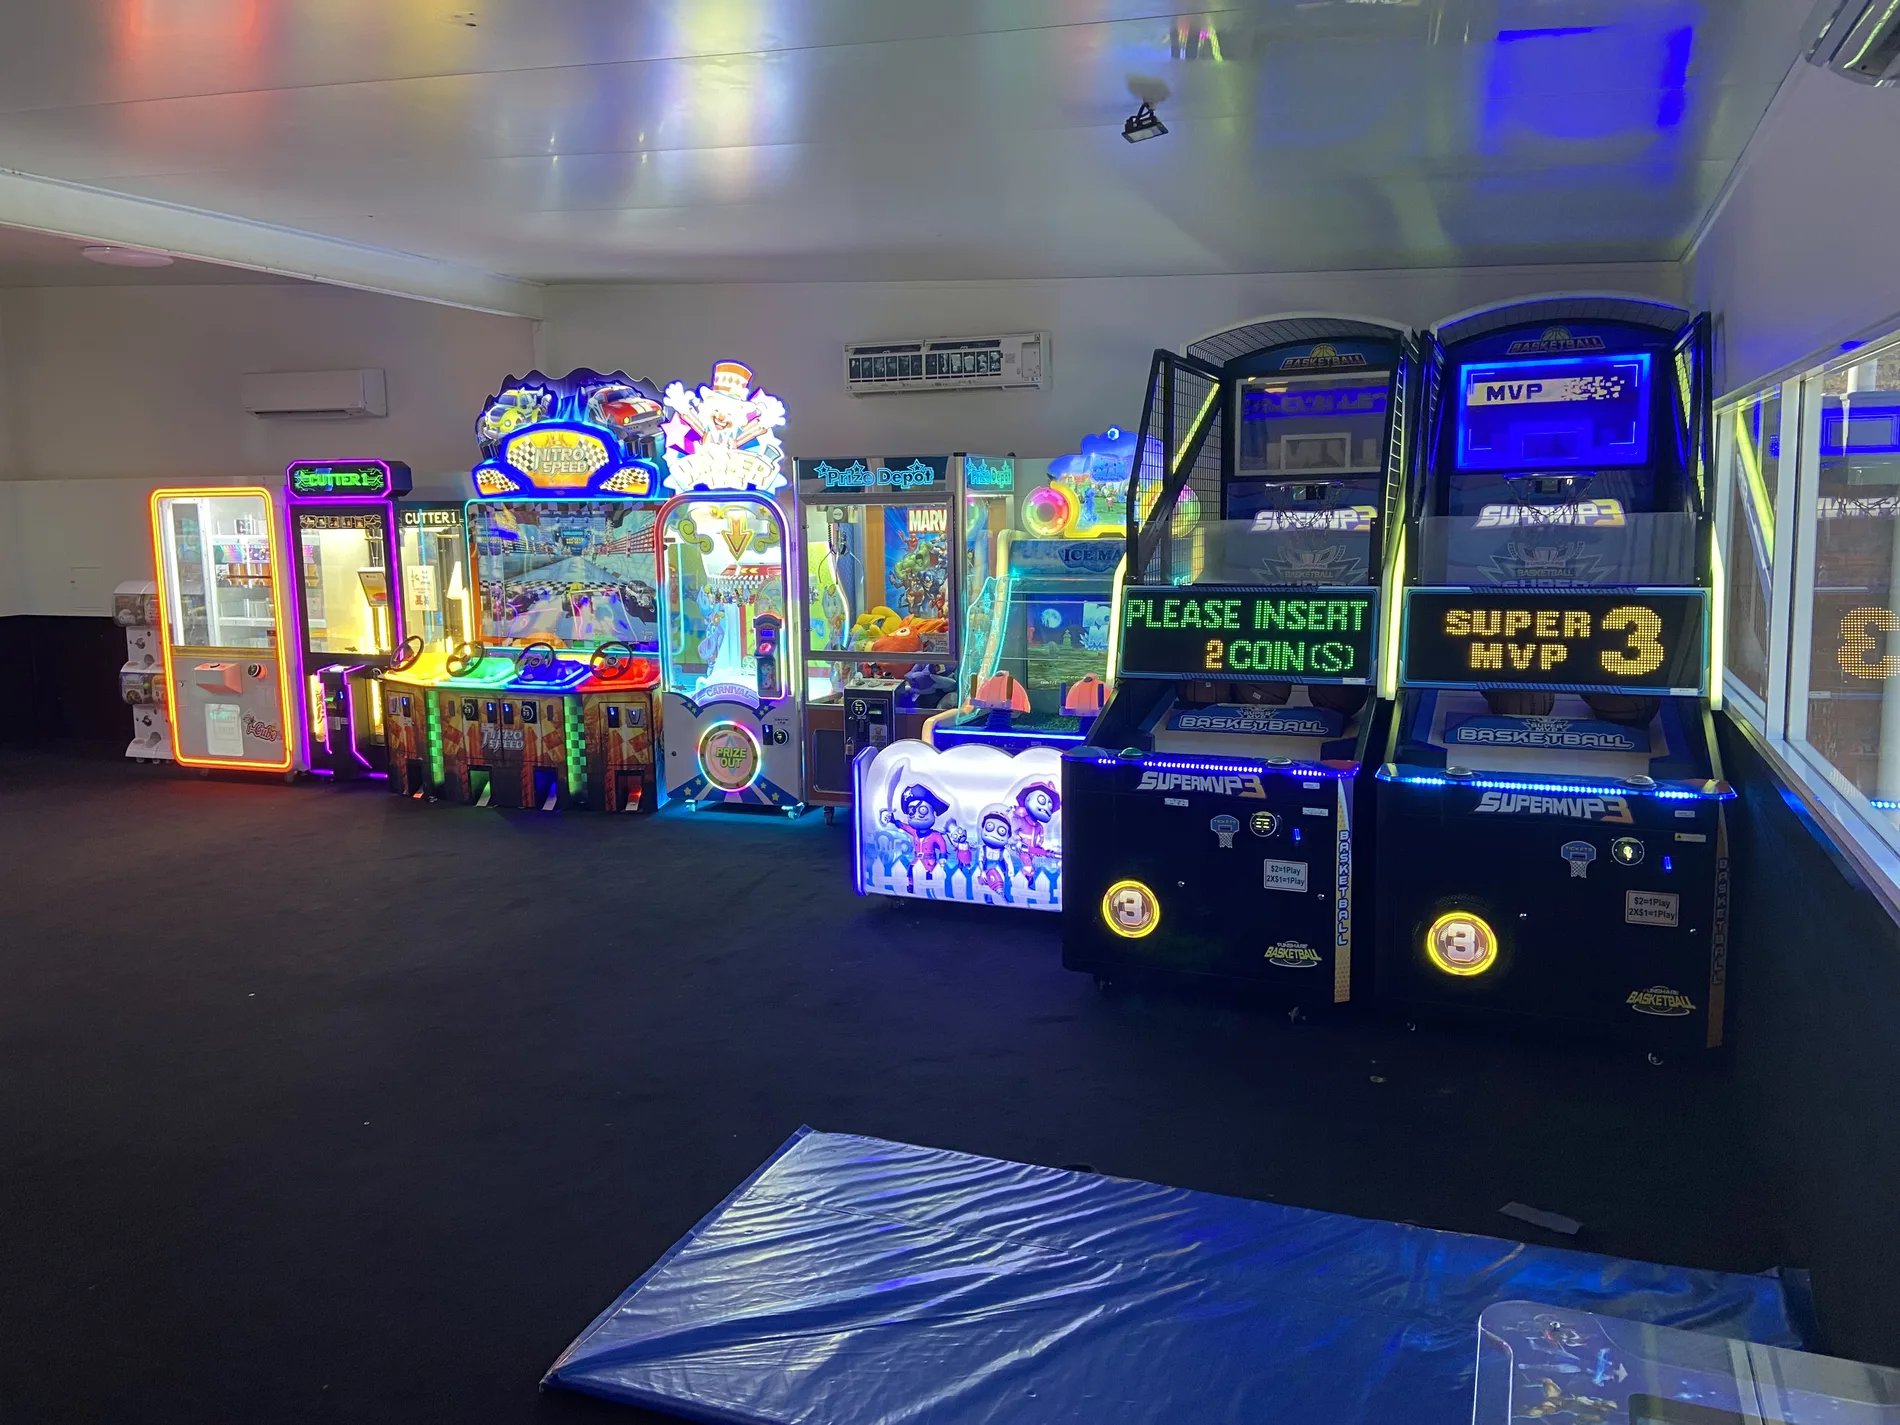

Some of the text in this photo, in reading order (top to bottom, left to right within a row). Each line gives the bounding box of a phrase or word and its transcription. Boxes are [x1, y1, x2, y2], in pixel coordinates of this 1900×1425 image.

[1511, 338, 1602, 353] BASKETBALL
[1283, 354, 1364, 369] BASKETBALL
[1486, 382, 1543, 402] MVP
[533, 447, 585, 471] NITRO
[543, 461, 588, 475] SPEED
[826, 467, 934, 489] Prize Depot
[1064, 548, 1093, 561] ICE
[1284, 570, 1334, 578] BASKETBALL
[1517, 568, 1574, 577] BASKETBALL
[1126, 599, 1242, 629] PLEASE
[1254, 600, 1369, 631] INSERT
[1446, 609, 1592, 638] SUPER
[1600, 605, 1665, 675] 3
[1205, 639, 1225, 669] 2
[1470, 642, 1568, 671] MVP
[706, 685, 750, 699] CARNIVAL
[1179, 716, 1328, 734] BASKETBALL
[1458, 727, 1634, 748] BASKETBALL
[715, 747, 747, 759] PRIZE
[720, 757, 743, 769] OUT
[1271, 865, 1301, 876] $2=1Play
[1266, 875, 1305, 886] 2X$1=1Play
[1338, 830, 1350, 946] BASKETBALL
[1119, 890, 1143, 925] 3
[1634, 897, 1670, 909] $2=1Play
[1629, 908, 1675, 921] 2X$1=1Play
[1711, 859, 1728, 985] BASKETBALL
[1447, 923, 1475, 961] 3
[1264, 946, 1322, 961] BASKETBALL
[1626, 991, 1696, 1010] BASKETBALL
